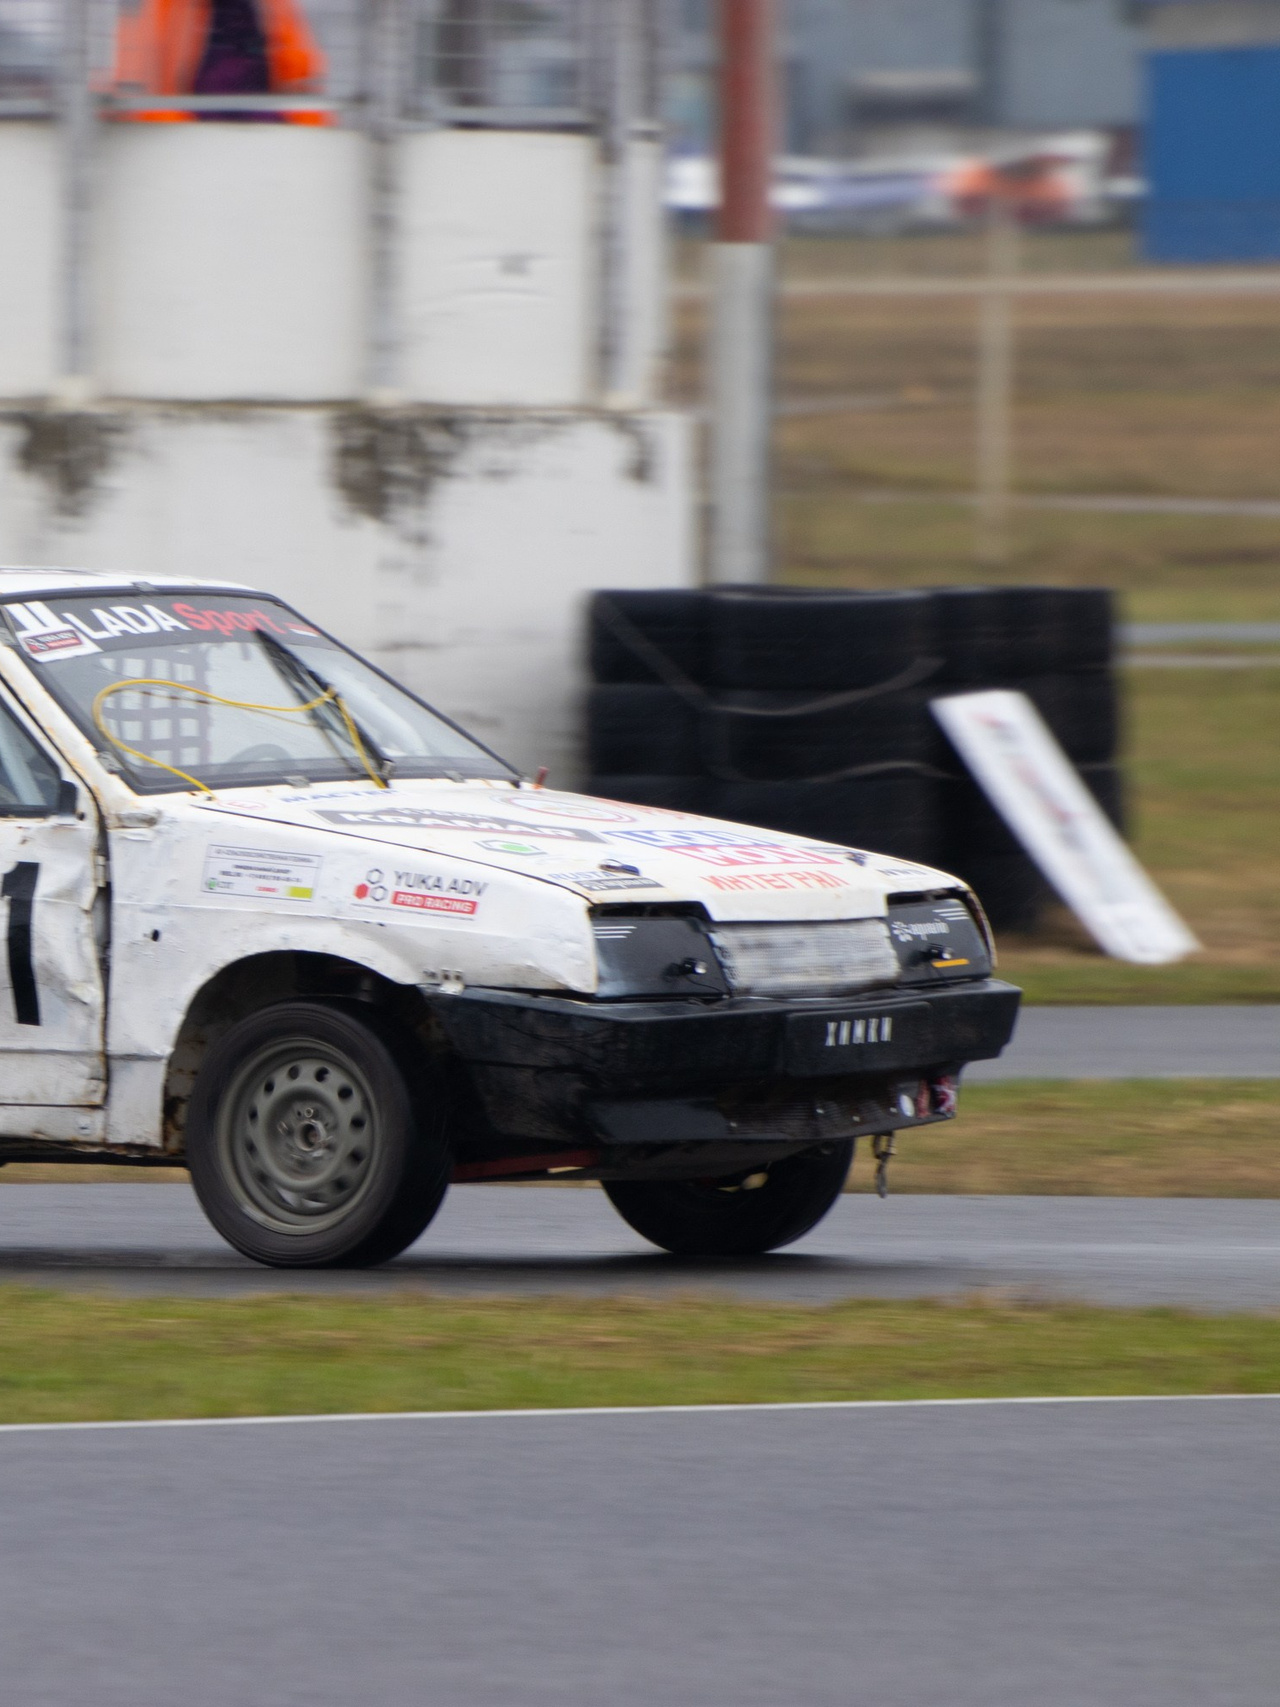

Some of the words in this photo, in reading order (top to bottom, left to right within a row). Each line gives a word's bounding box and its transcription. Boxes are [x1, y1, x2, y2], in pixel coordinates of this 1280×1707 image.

[62, 604, 191, 640] LADA
[171, 602, 286, 636] Sport
[338, 812, 582, 839] KRAMAR
[677, 846, 832, 864] MOLY
[393, 870, 443, 891] YUKA
[446, 878, 490, 897] ADV
[395, 893, 423, 906] PRO
[423, 896, 474, 913] RACING
